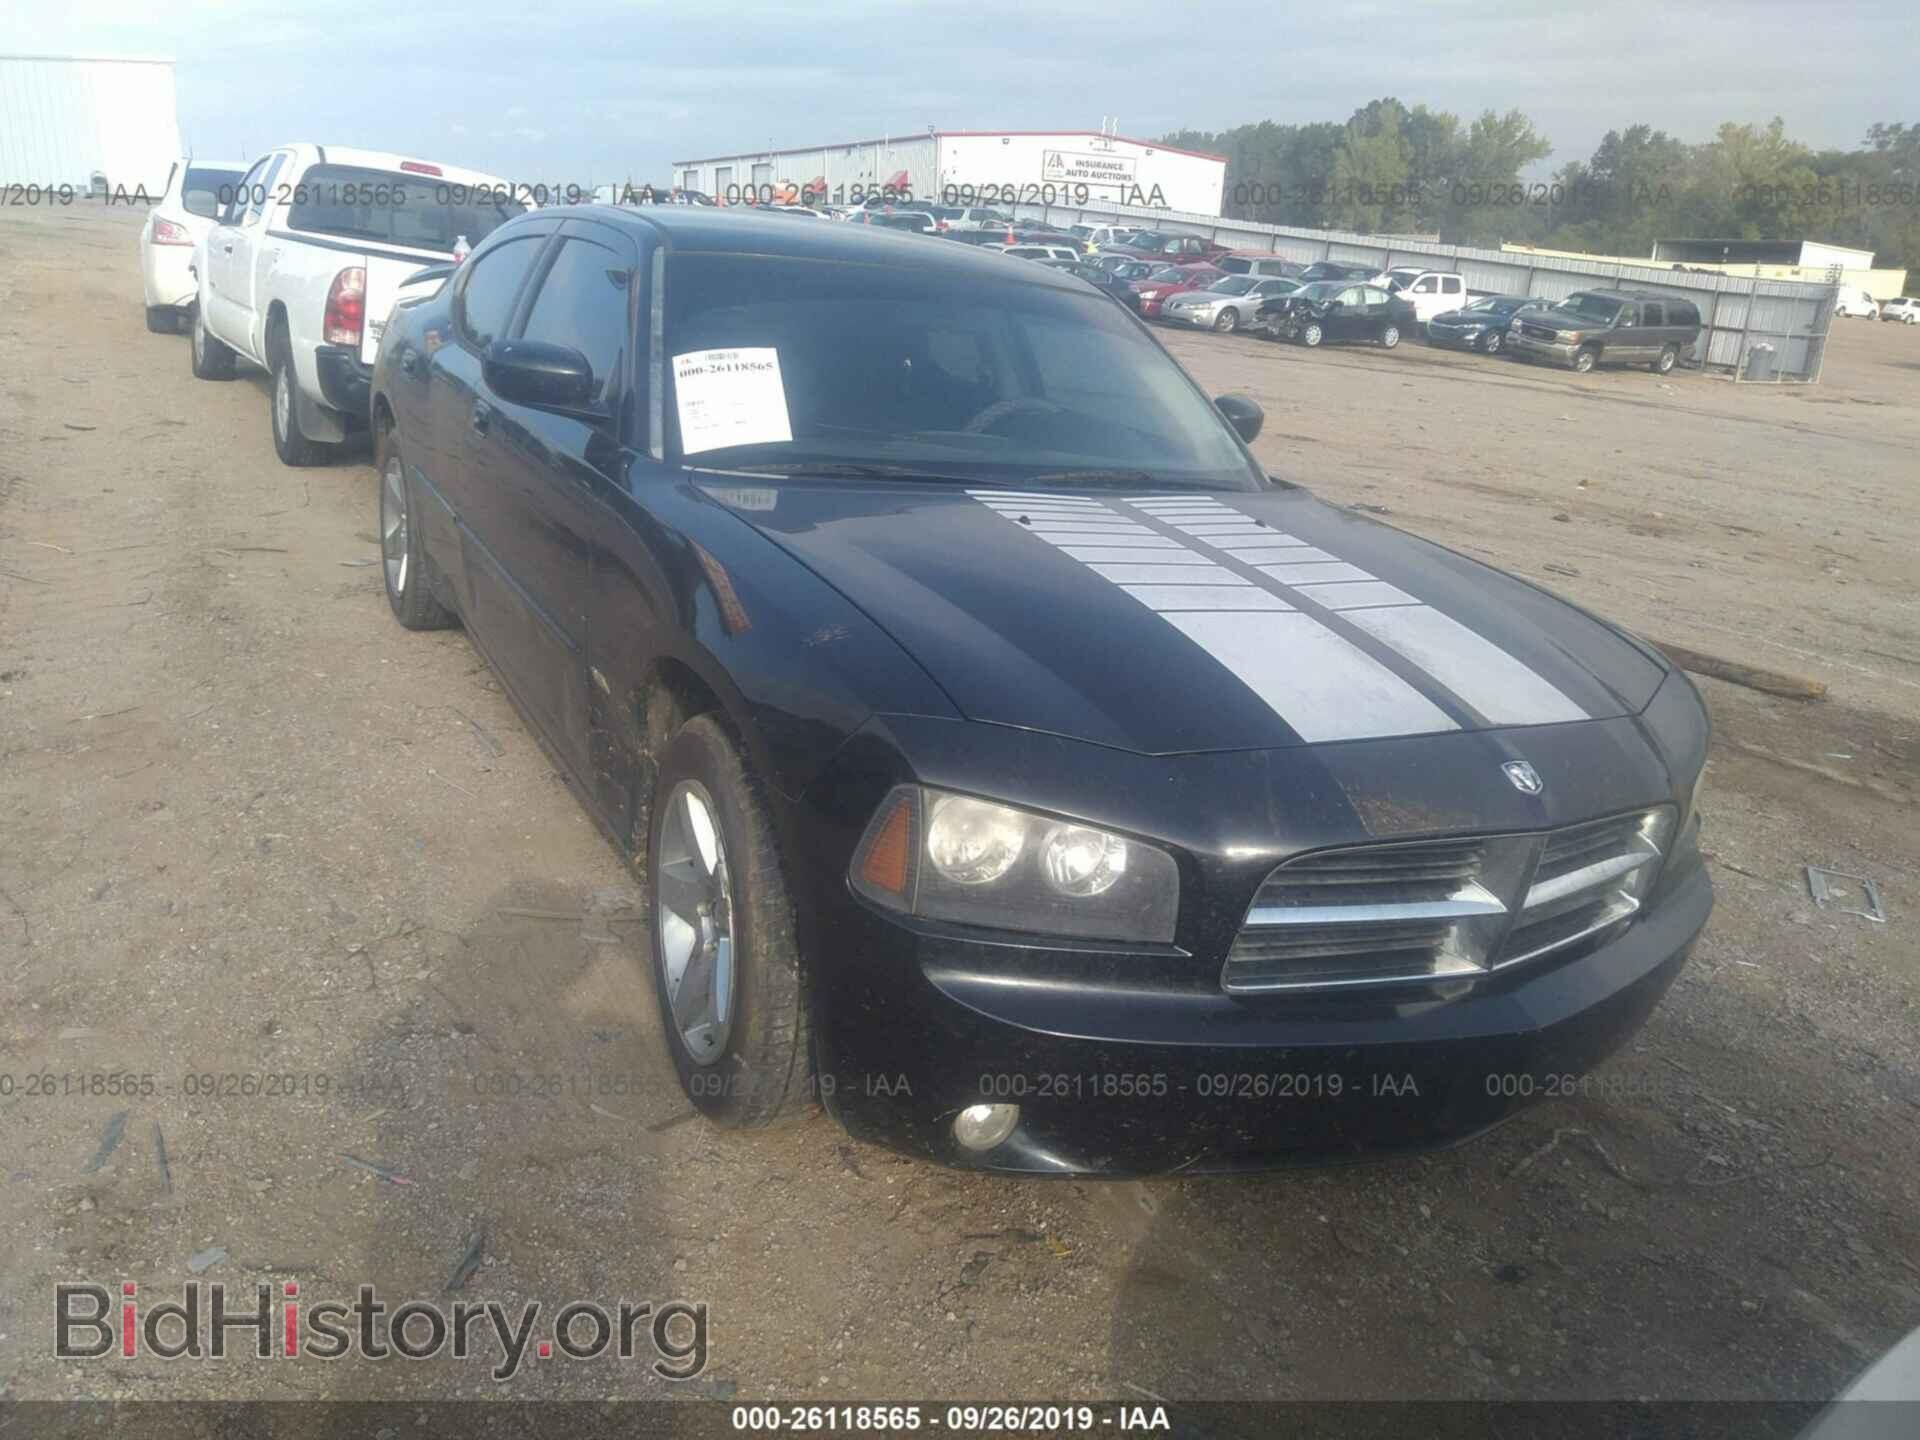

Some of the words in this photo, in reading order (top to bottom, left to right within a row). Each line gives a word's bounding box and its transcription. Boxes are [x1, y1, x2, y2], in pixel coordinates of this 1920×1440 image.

[1075, 160, 1124, 171] INSURANCE
[1065, 169, 1089, 178] AUTO
[1090, 171, 1132, 181] AUCTIONS
[680, 362, 774, 377] 000-26118565
